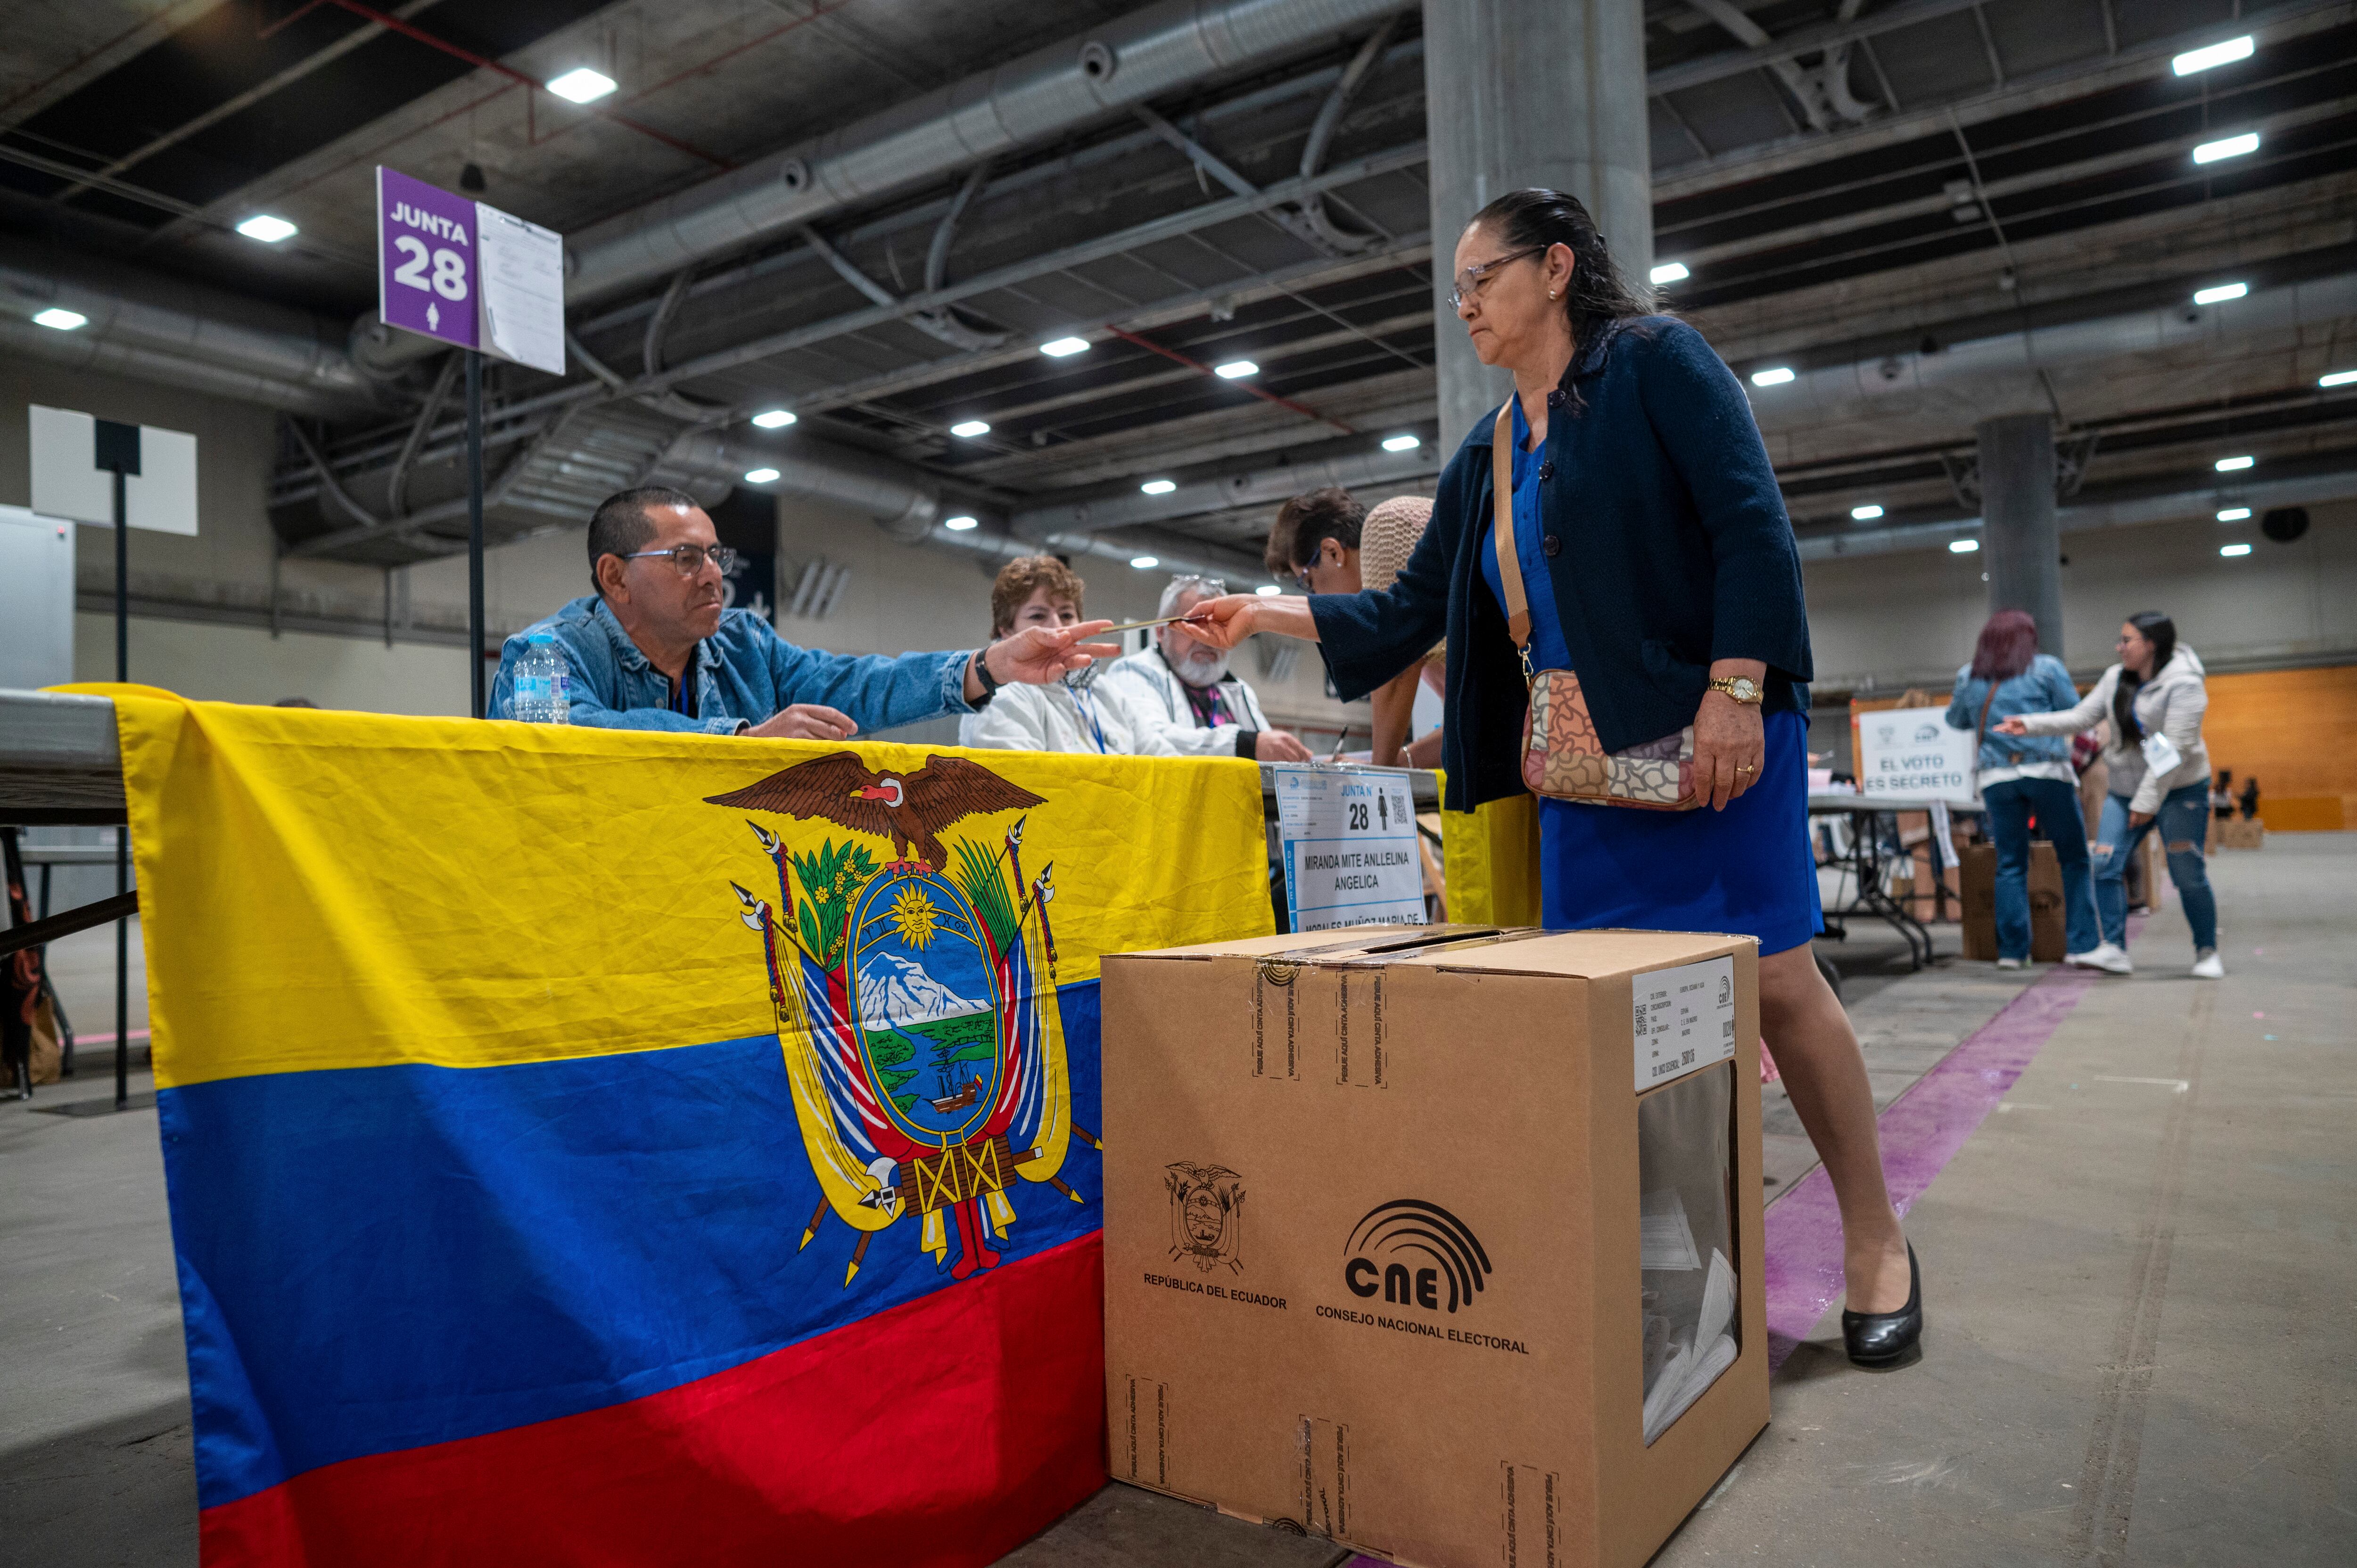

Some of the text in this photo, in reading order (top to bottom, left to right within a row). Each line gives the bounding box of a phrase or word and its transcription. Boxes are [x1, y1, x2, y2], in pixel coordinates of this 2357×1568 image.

[390, 201, 469, 246] JUNTA
[394, 235, 468, 301] 28
[1880, 754, 1944, 772] EL VOTO
[1341, 785, 1365, 796] JUNTA
[1866, 772, 1962, 791] ES SECRETO
[1349, 803, 1368, 830] 28
[1305, 852, 1409, 870] MIRANDA MITE ANLLELINA
[1335, 875, 1379, 891] ANGELICA
[1144, 1272, 1287, 1310] REPÚBLICA DEL ECUADOR
[1316, 1305, 1529, 1355] CONSEJO NACIONAL ELECTORAL
